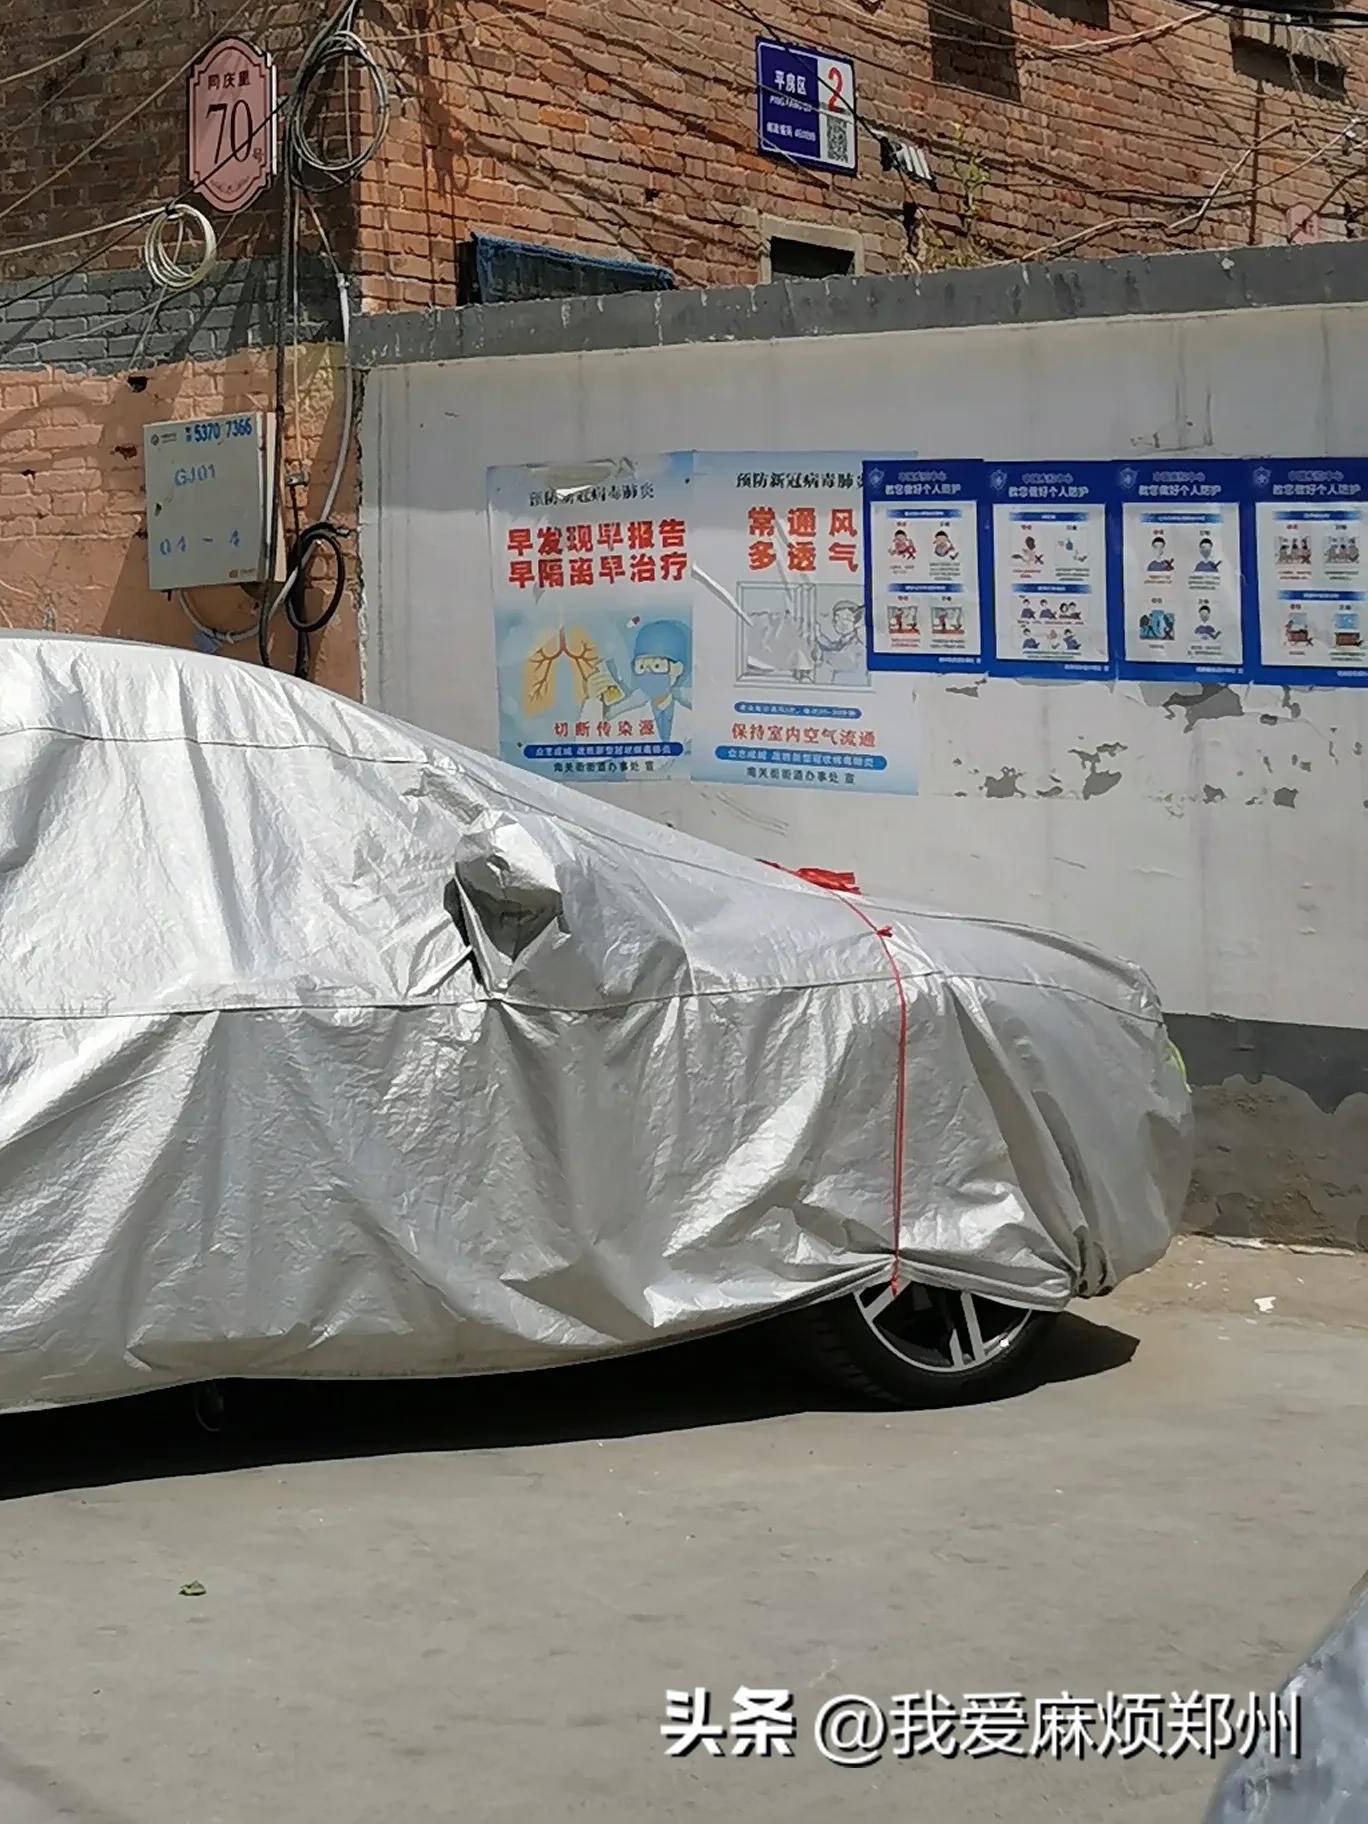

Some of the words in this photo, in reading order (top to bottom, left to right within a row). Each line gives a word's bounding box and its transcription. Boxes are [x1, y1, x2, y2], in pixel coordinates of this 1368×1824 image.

[827, 66, 843, 113] 2
[206, 99, 253, 165] 70
[507, 518, 686, 557] 早发现早报告
[747, 506, 858, 538] 常通风
[509, 551, 688, 589] 早隔离早治疗
[748, 540, 859, 573] 多透气
[554, 719, 655, 738] 切断传染源
[732, 722, 876, 748] 保持室内空气流通
